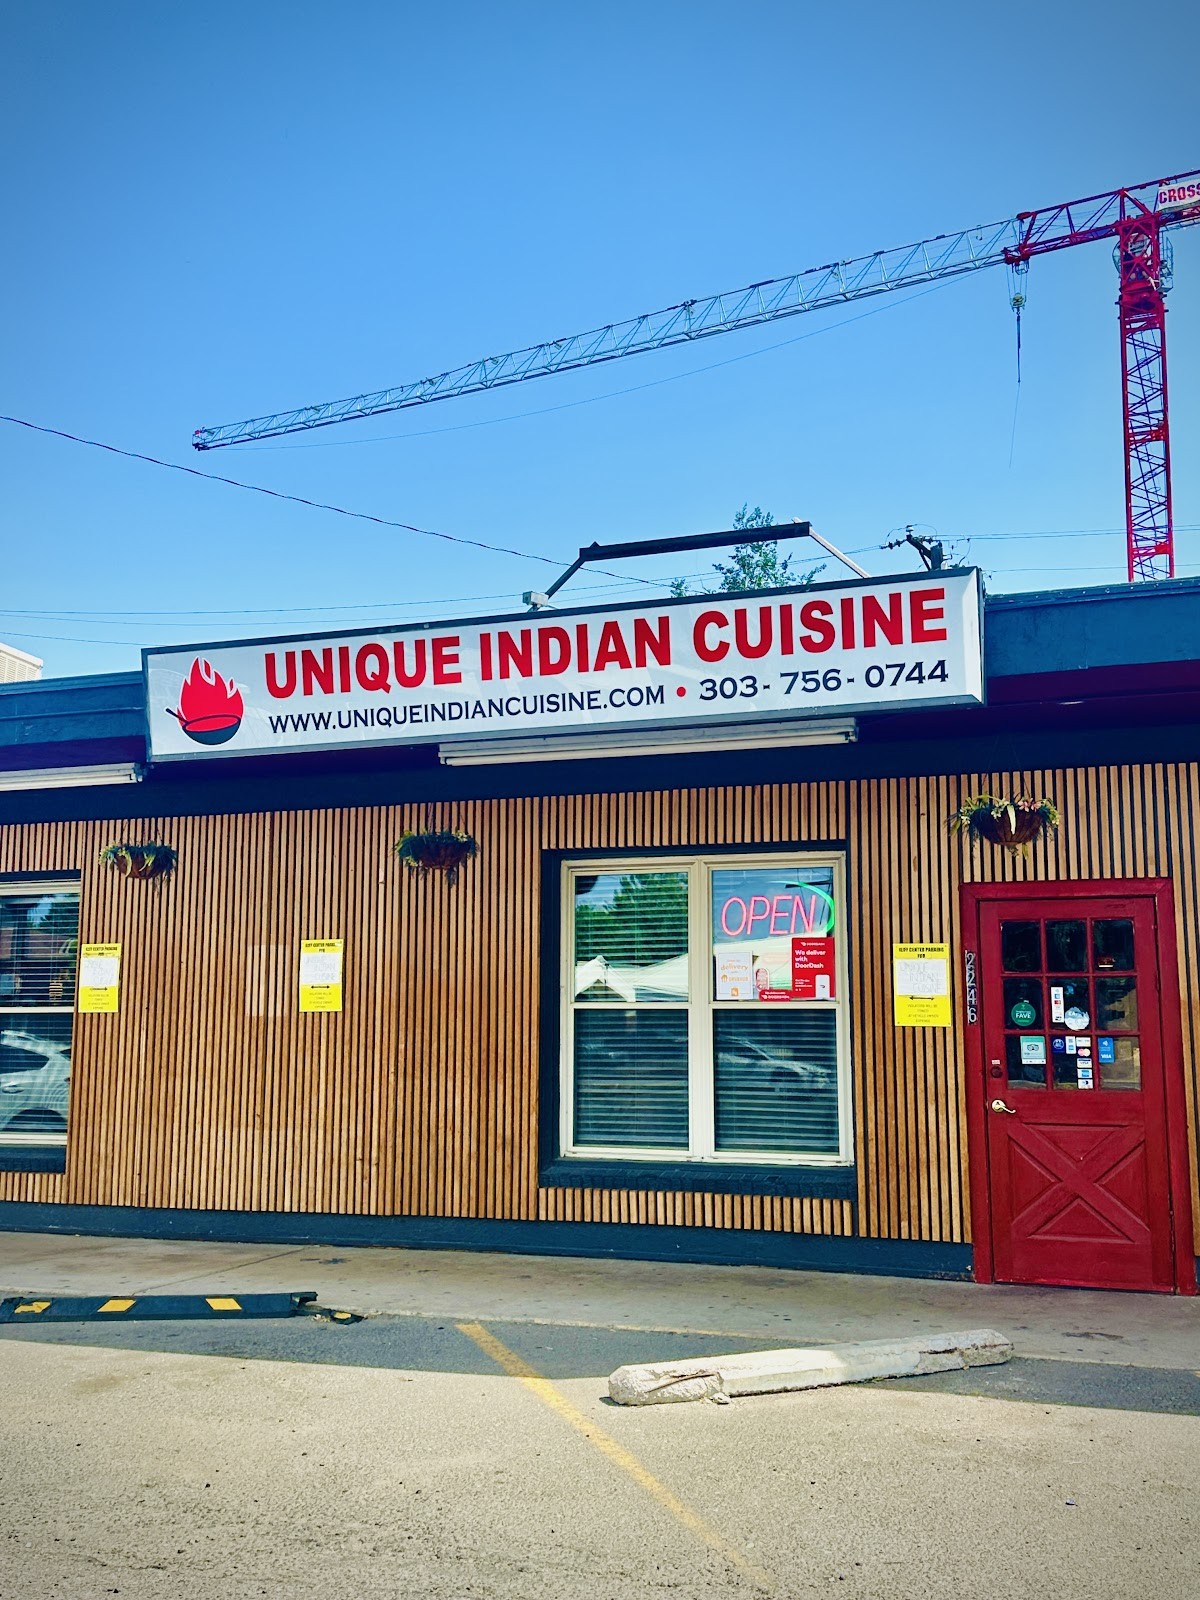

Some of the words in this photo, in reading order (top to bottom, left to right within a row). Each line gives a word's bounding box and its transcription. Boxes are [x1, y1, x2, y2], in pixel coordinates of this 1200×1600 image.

[264, 635, 463, 699] UNIQUE
[479, 616, 671, 682] INDIAN
[693, 588, 948, 663] CUISINE
[268, 684, 665, 734] WWW.UNIQUEINDIANCUISINE.COM
[864, 659, 949, 689] 0744
[721, 895, 817, 936] OPEN
